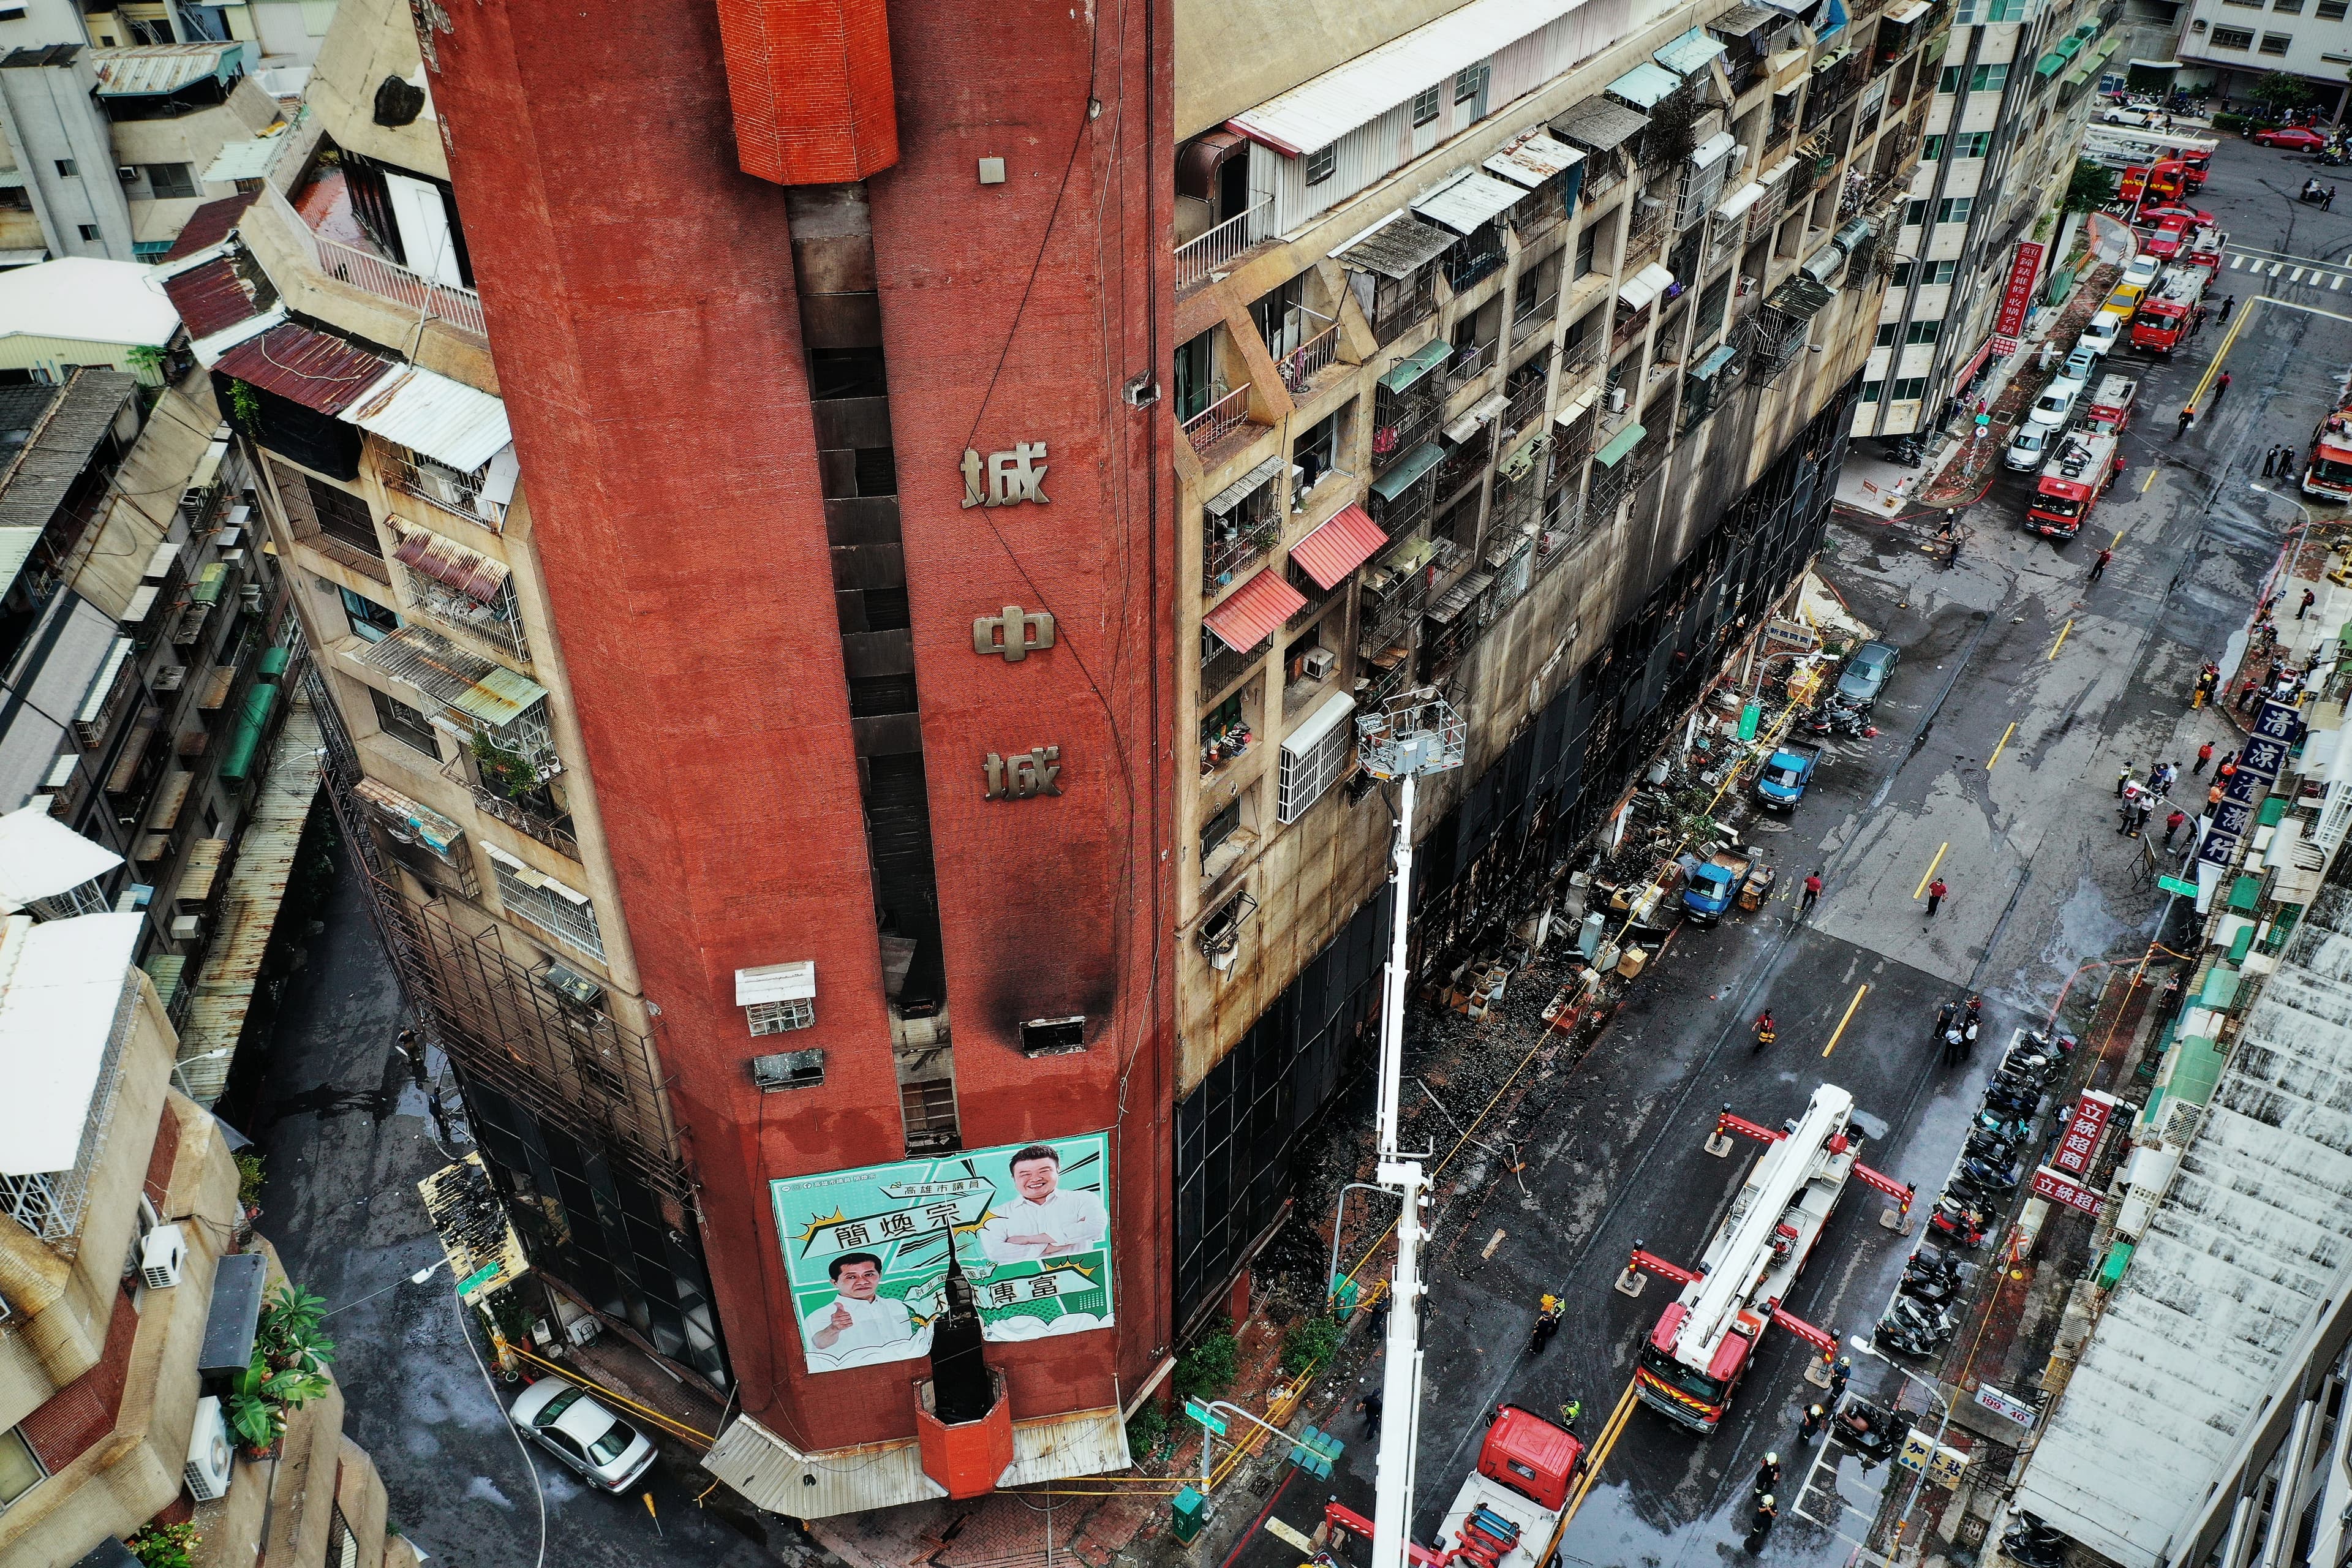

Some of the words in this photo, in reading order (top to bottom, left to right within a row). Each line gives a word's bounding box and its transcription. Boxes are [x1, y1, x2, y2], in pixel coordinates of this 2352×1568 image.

[960, 440, 1063, 802] 城中城
[2059, 1102, 2104, 1170] 立統超商
[903, 1179, 981, 1196] 高雄市議員
[834, 1202, 962, 1250] 簡煥宗
[1982, 1396, 2001, 1409] 199
[2009, 1411, 2025, 1422] 40
[1906, 1441, 1961, 1477] 加水站
